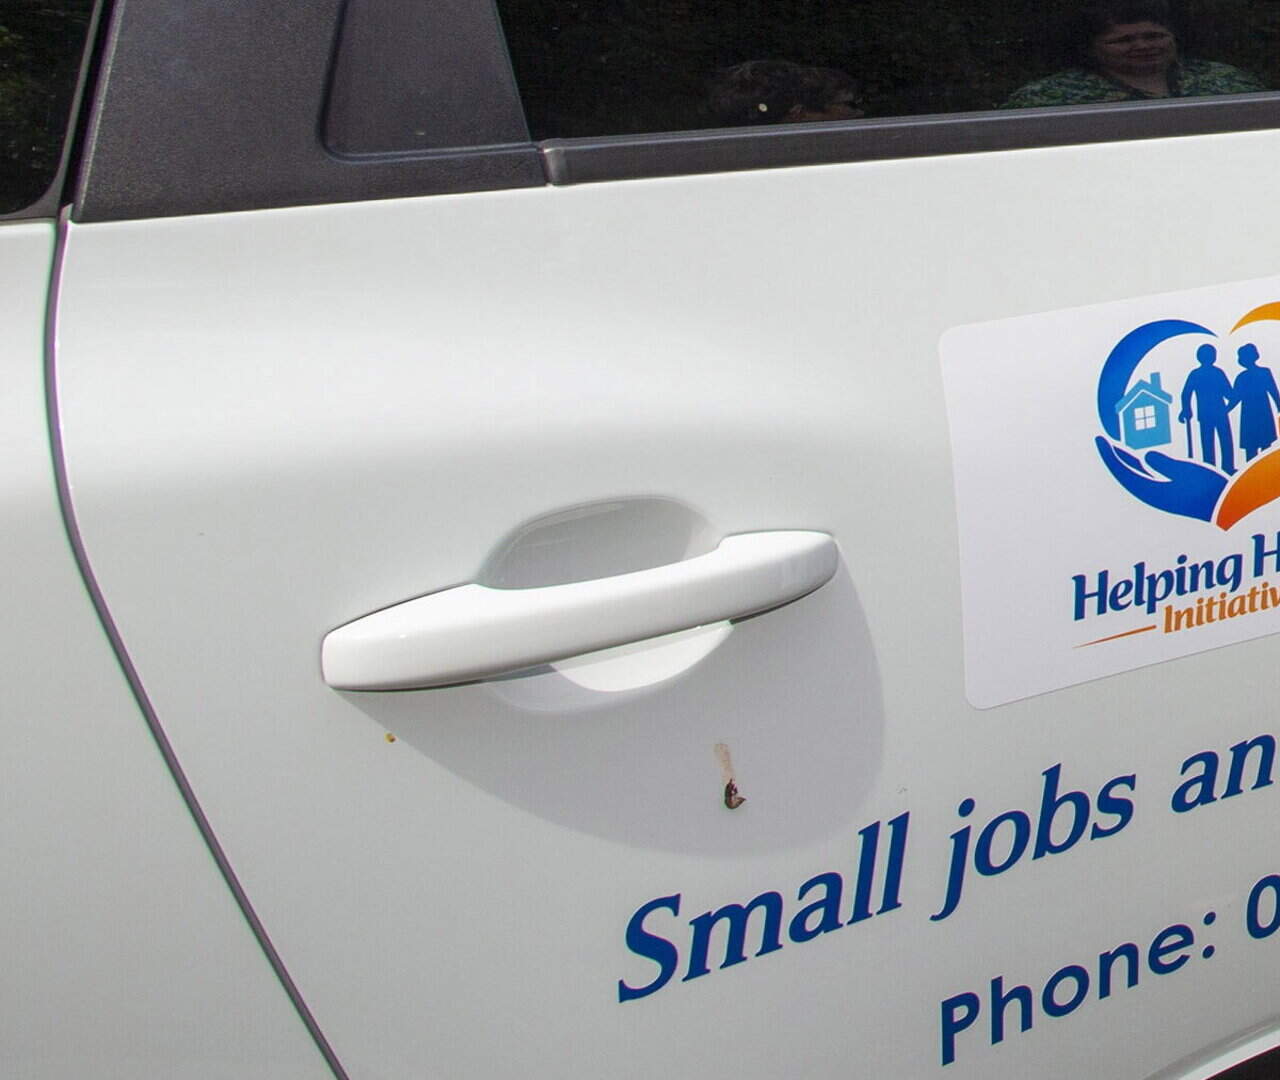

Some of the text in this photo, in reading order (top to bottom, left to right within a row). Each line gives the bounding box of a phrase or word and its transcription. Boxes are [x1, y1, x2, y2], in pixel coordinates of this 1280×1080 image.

[1072, 554, 1243, 621] Helping
[618, 811, 910, 1003] Small
[930, 763, 1136, 922] jobs
[940, 910, 1216, 1067] Phone:
